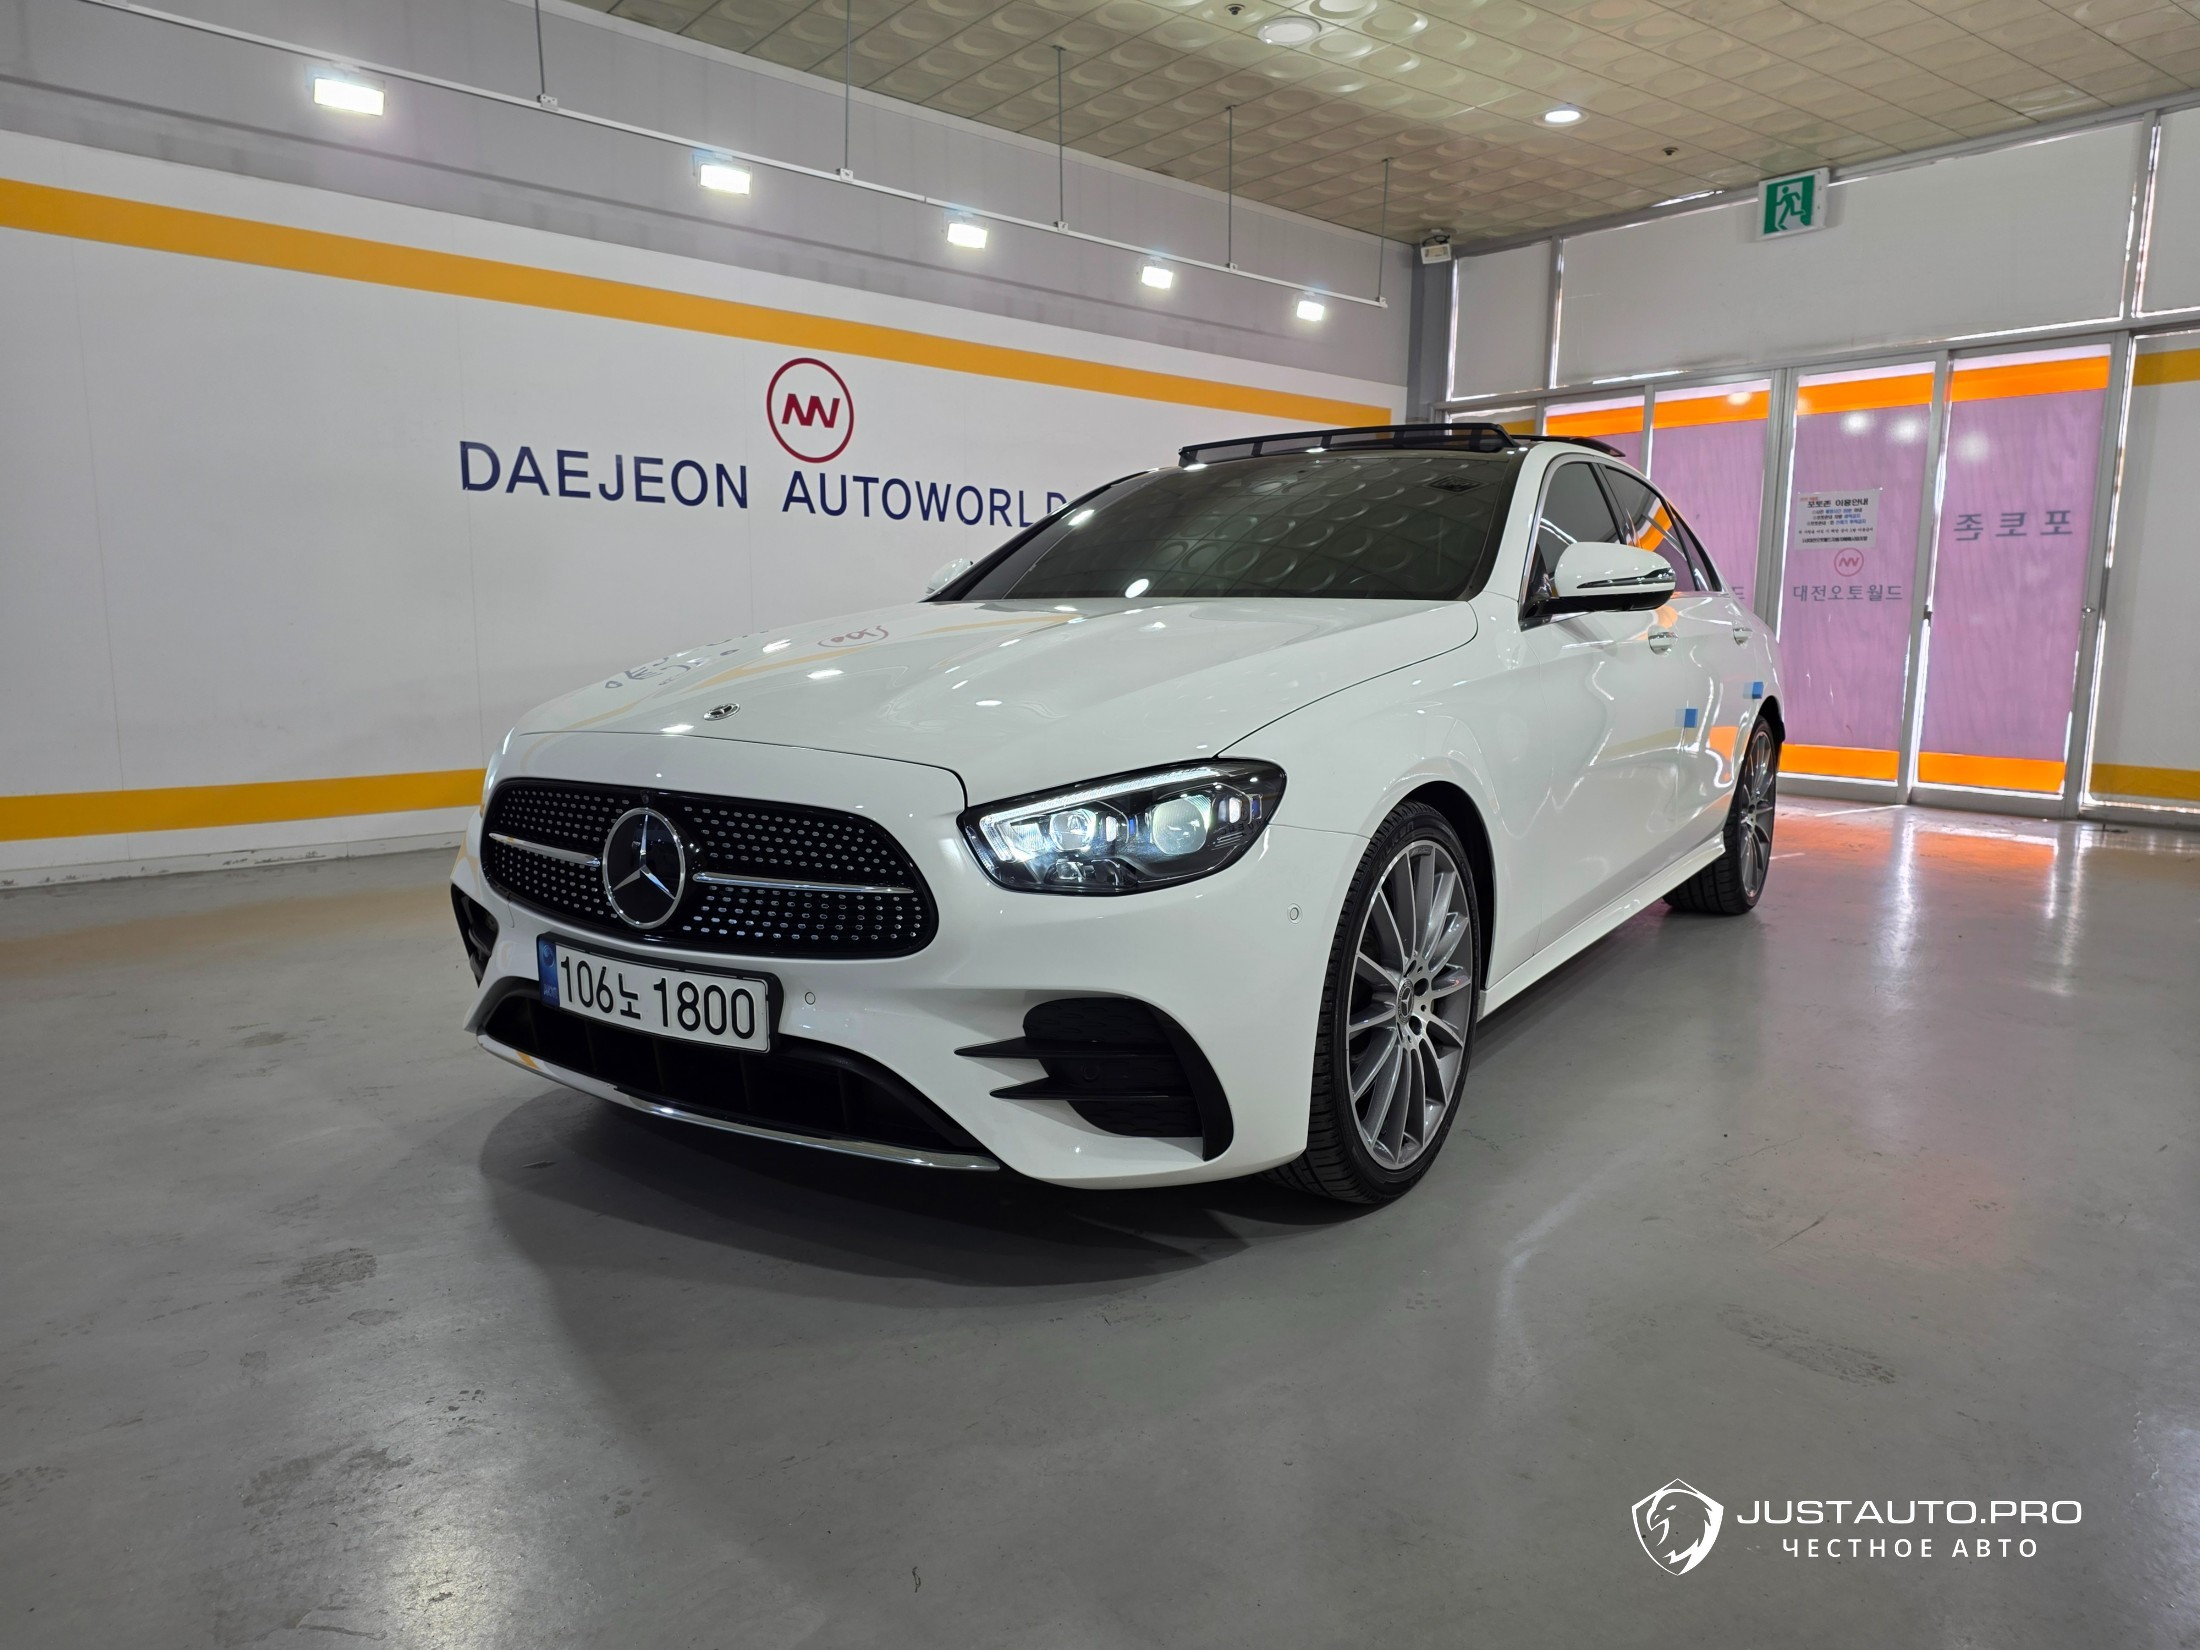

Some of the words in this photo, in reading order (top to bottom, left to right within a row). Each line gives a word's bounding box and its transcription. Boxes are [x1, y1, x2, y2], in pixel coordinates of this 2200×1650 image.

[459, 440, 748, 509] DAEJEON
[1835, 498, 1869, 507] 이용안내
[1793, 584, 1903, 602] 대전오토월드
[560, 956, 641, 1020] 106노
[653, 977, 755, 1040] 1800
